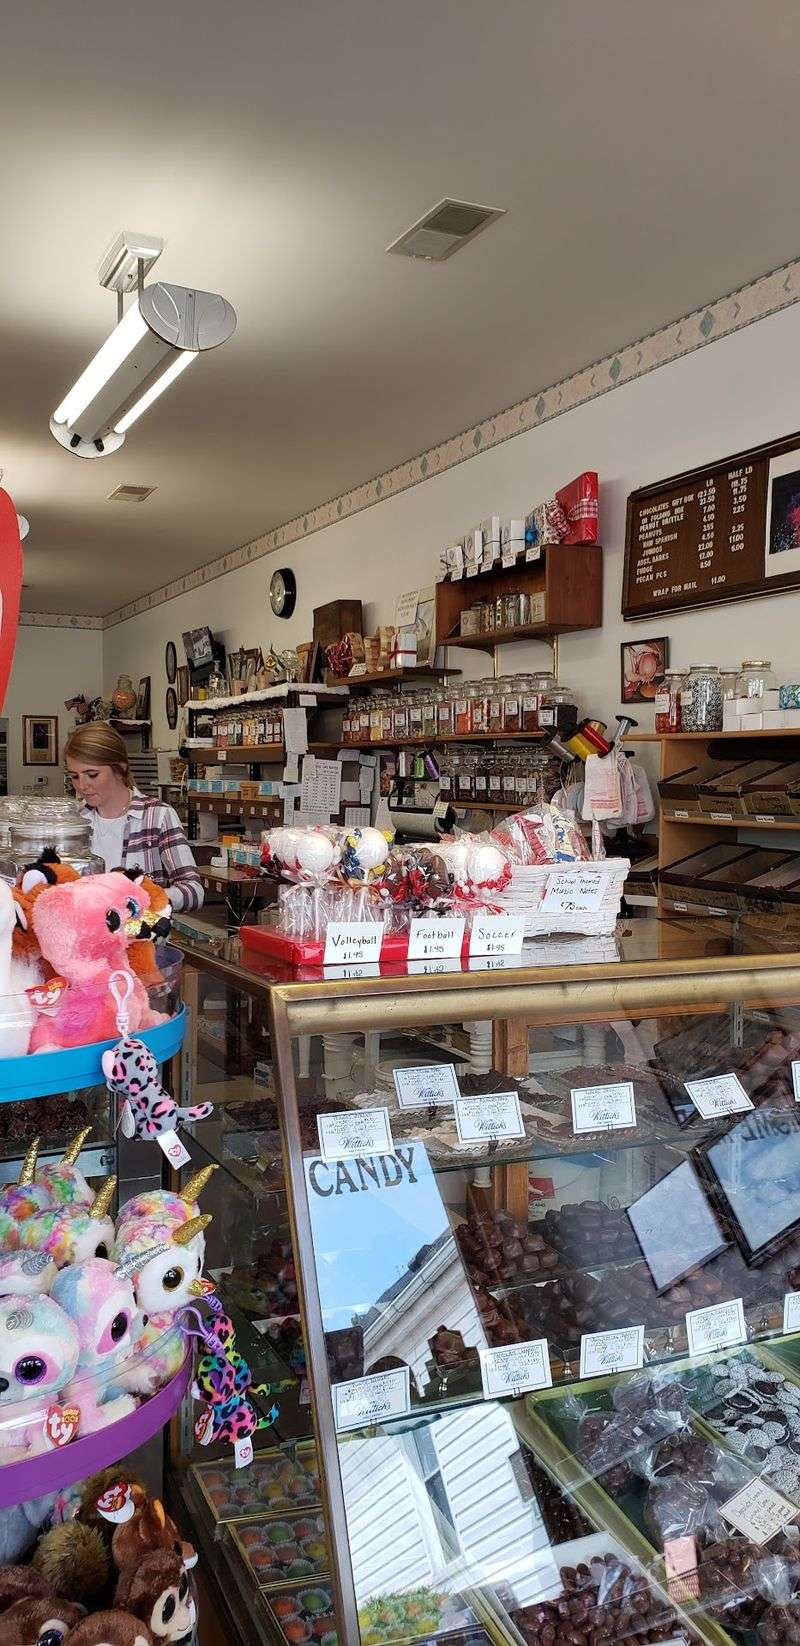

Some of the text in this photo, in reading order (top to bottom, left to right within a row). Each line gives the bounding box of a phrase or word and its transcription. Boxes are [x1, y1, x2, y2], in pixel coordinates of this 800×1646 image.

[728, 469, 743, 480] HALF
[639, 502, 669, 517] CHOCOLATES
[672, 497, 683, 507] GIFT
[684, 494, 694, 504] BOX
[651, 510, 671, 522] FOLDING
[674, 506, 684, 515] BOX
[640, 521, 659, 533] PEANUT
[662, 513, 684, 526] BRITTLE
[639, 528, 663, 541] PEANUTS
[643, 539, 654, 549] RAW
[655, 532, 678, 545] SPANISH
[636, 573, 654, 584] PECAN
[656, 570, 668, 580] PCS
[637, 565, 653, 576] FUDGE
[652, 575, 726, 598] WRAP FOR MAIL 11.00
[550, 887, 573, 895] Music
[417, 928, 454, 939] Football
[478, 928, 517, 940] Soccer
[332, 934, 377, 949] Volleyball
[309, 1147, 418, 1197] CANDY
